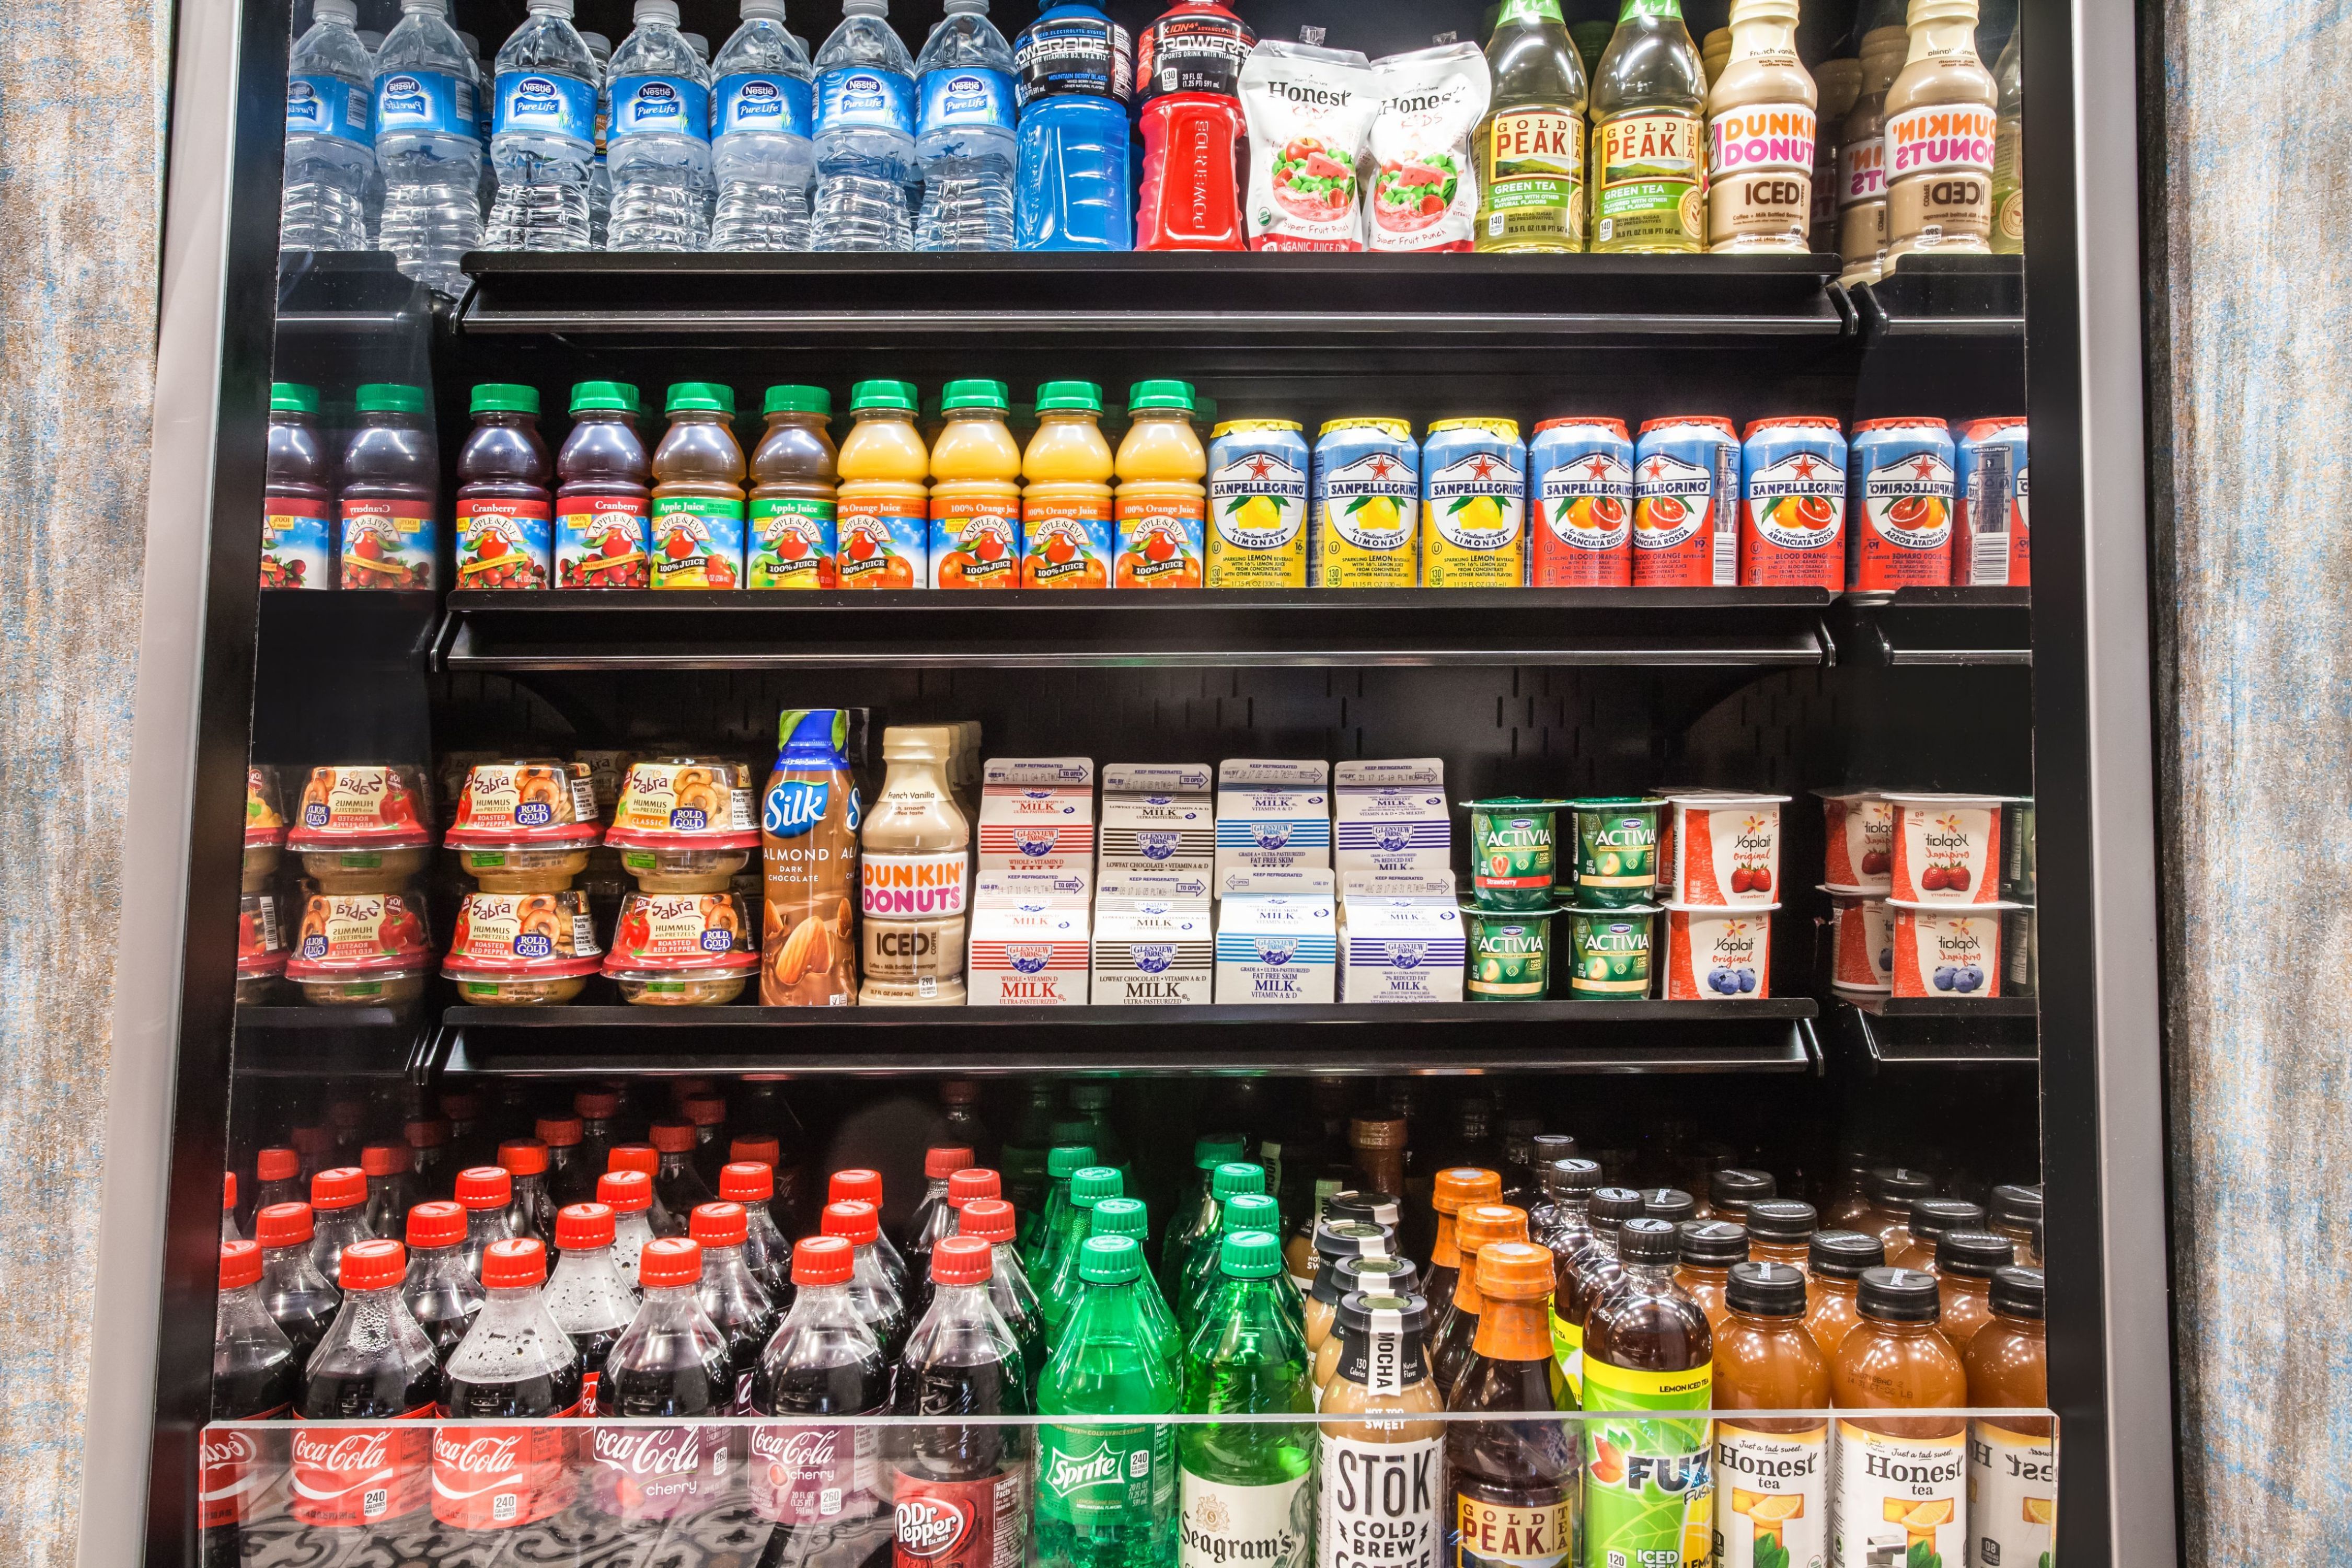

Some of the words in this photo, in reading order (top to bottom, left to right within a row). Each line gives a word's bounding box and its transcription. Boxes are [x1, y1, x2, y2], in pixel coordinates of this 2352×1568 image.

[1161, 52, 1182, 61] SPORTS
[1163, 71, 1175, 79] 130
[1268, 80, 1352, 107] Honest
[517, 102, 537, 112] Pure
[538, 101, 557, 111] Life
[637, 106, 659, 117] Pure
[659, 105, 676, 113] Life
[1497, 119, 1567, 133] GOLD
[1607, 122, 1677, 139] GOLD
[1497, 131, 1566, 158] PEAK
[1607, 134, 1675, 164] PEAK
[1494, 182, 1534, 194] GREEN
[1535, 181, 1557, 192] TEA
[1604, 187, 1639, 201] GREEN
[1643, 185, 1665, 194] TEA
[1746, 181, 1800, 205] ICED
[1494, 194, 1523, 203] FLAVORED
[1490, 215, 1502, 225] 140
[1600, 221, 1611, 231] 140
[1214, 483, 1304, 494] SANPELLEGRINO
[1331, 483, 1417, 496] SANPELLEGRINO
[1434, 483, 1523, 495] SANPELLEGRINO
[1547, 483, 1632, 495] SANPELLEGRINO
[1753, 483, 1843, 496] SANPELLEGRINO
[472, 504, 516, 515] Cranberry
[595, 501, 639, 513] Cranberry
[660, 503, 682, 513] Apple
[683, 502, 705, 511] Juice
[770, 503, 792, 513] Apple
[794, 503, 817, 513] Juice
[849, 503, 878, 513] Orange
[879, 503, 901, 512] Juice
[1028, 508, 1044, 516] 100%
[1046, 506, 1077, 515] Orange
[1078, 506, 1098, 515] Juice
[1125, 505, 1144, 514] 100%
[1146, 504, 1177, 514] Orange
[1178, 505, 1195, 514] Juice
[1231, 534, 1286, 547] LIMONATA
[1454, 535, 1508, 547] LIMONATA
[660, 563, 679, 572] 100%
[679, 559, 705, 568] JUICE
[770, 563, 792, 573] 100%
[792, 560, 817, 569] JUICE
[475, 773, 510, 794] Sabra
[633, 771, 668, 794] Sabra
[887, 791, 908, 800] French
[910, 791, 935, 799] Vanilla
[522, 804, 547, 813] ROLD
[677, 810, 702, 819] ROLD
[764, 787, 823, 832] Silk
[518, 812, 549, 824] GOLD
[631, 817, 664, 826] CLASSIC
[673, 818, 704, 828] GOLD
[1017, 829, 1055, 838] GLENVIEW
[1139, 833, 1178, 841] GLENVIEW
[1486, 829, 1551, 847] ACTIVIA
[1734, 834, 1772, 852] Yoplait
[763, 848, 829, 861] ALMOND
[864, 861, 965, 887] DUNKIN'
[864, 886, 960, 914] DONUTS
[472, 899, 511, 920] Sabra
[876, 932, 930, 956] ICED
[1478, 936, 1544, 952] ACTIVIA
[1585, 935, 1649, 950] ACTIVIA
[1714, 937, 1754, 955] Yoplait
[1009, 946, 1050, 955] GLENVIEW
[1001, 983, 1057, 998] MILK
[1126, 983, 1181, 998] MILK
[1255, 981, 1295, 991] MILK
[1356, 1358, 1367, 1369] 130
[1377, 1332, 1396, 1389] MOCHA
[1403, 1359, 1417, 1370] Natural
[1350, 1367, 1366, 1378] Calories
[1688, 1381, 1701, 1390] ICED
[1365, 1421, 1405, 1430] SWEET
[292, 1428, 394, 1471] Coca-Cola
[433, 1427, 524, 1473] Coca-Cola
[752, 1426, 840, 1465] Coca-Cola
[1719, 1443, 1818, 1478] Honest
[1052, 1451, 1115, 1490] Sprite
[1865, 1453, 1963, 1483] Honest
[790, 1469, 835, 1482] cherry
[647, 1480, 697, 1497] cherry
[996, 1477, 1018, 1491] Nutrition
[1758, 1477, 1781, 1489] tea
[1911, 1483, 1933, 1496] tea
[366, 1491, 385, 1504] 240
[823, 1491, 839, 1503] 260
[996, 1488, 1011, 1500] Facts
[496, 1497, 515, 1508] 240
[909, 1503, 937, 1523] Dr
[1463, 1503, 1545, 1525] GOLD
[895, 1503, 955, 1548] Pepper
[1353, 1520, 1415, 1539] COLD
[1557, 1506, 1568, 1551] TEA
[1181, 1511, 1292, 1563] Seagram's
[1463, 1516, 1545, 1555] PEAK
[1354, 1539, 1416, 1558] BREW
[1609, 1552, 1624, 1566] 120
[1636, 1549, 1680, 1564] ICED
